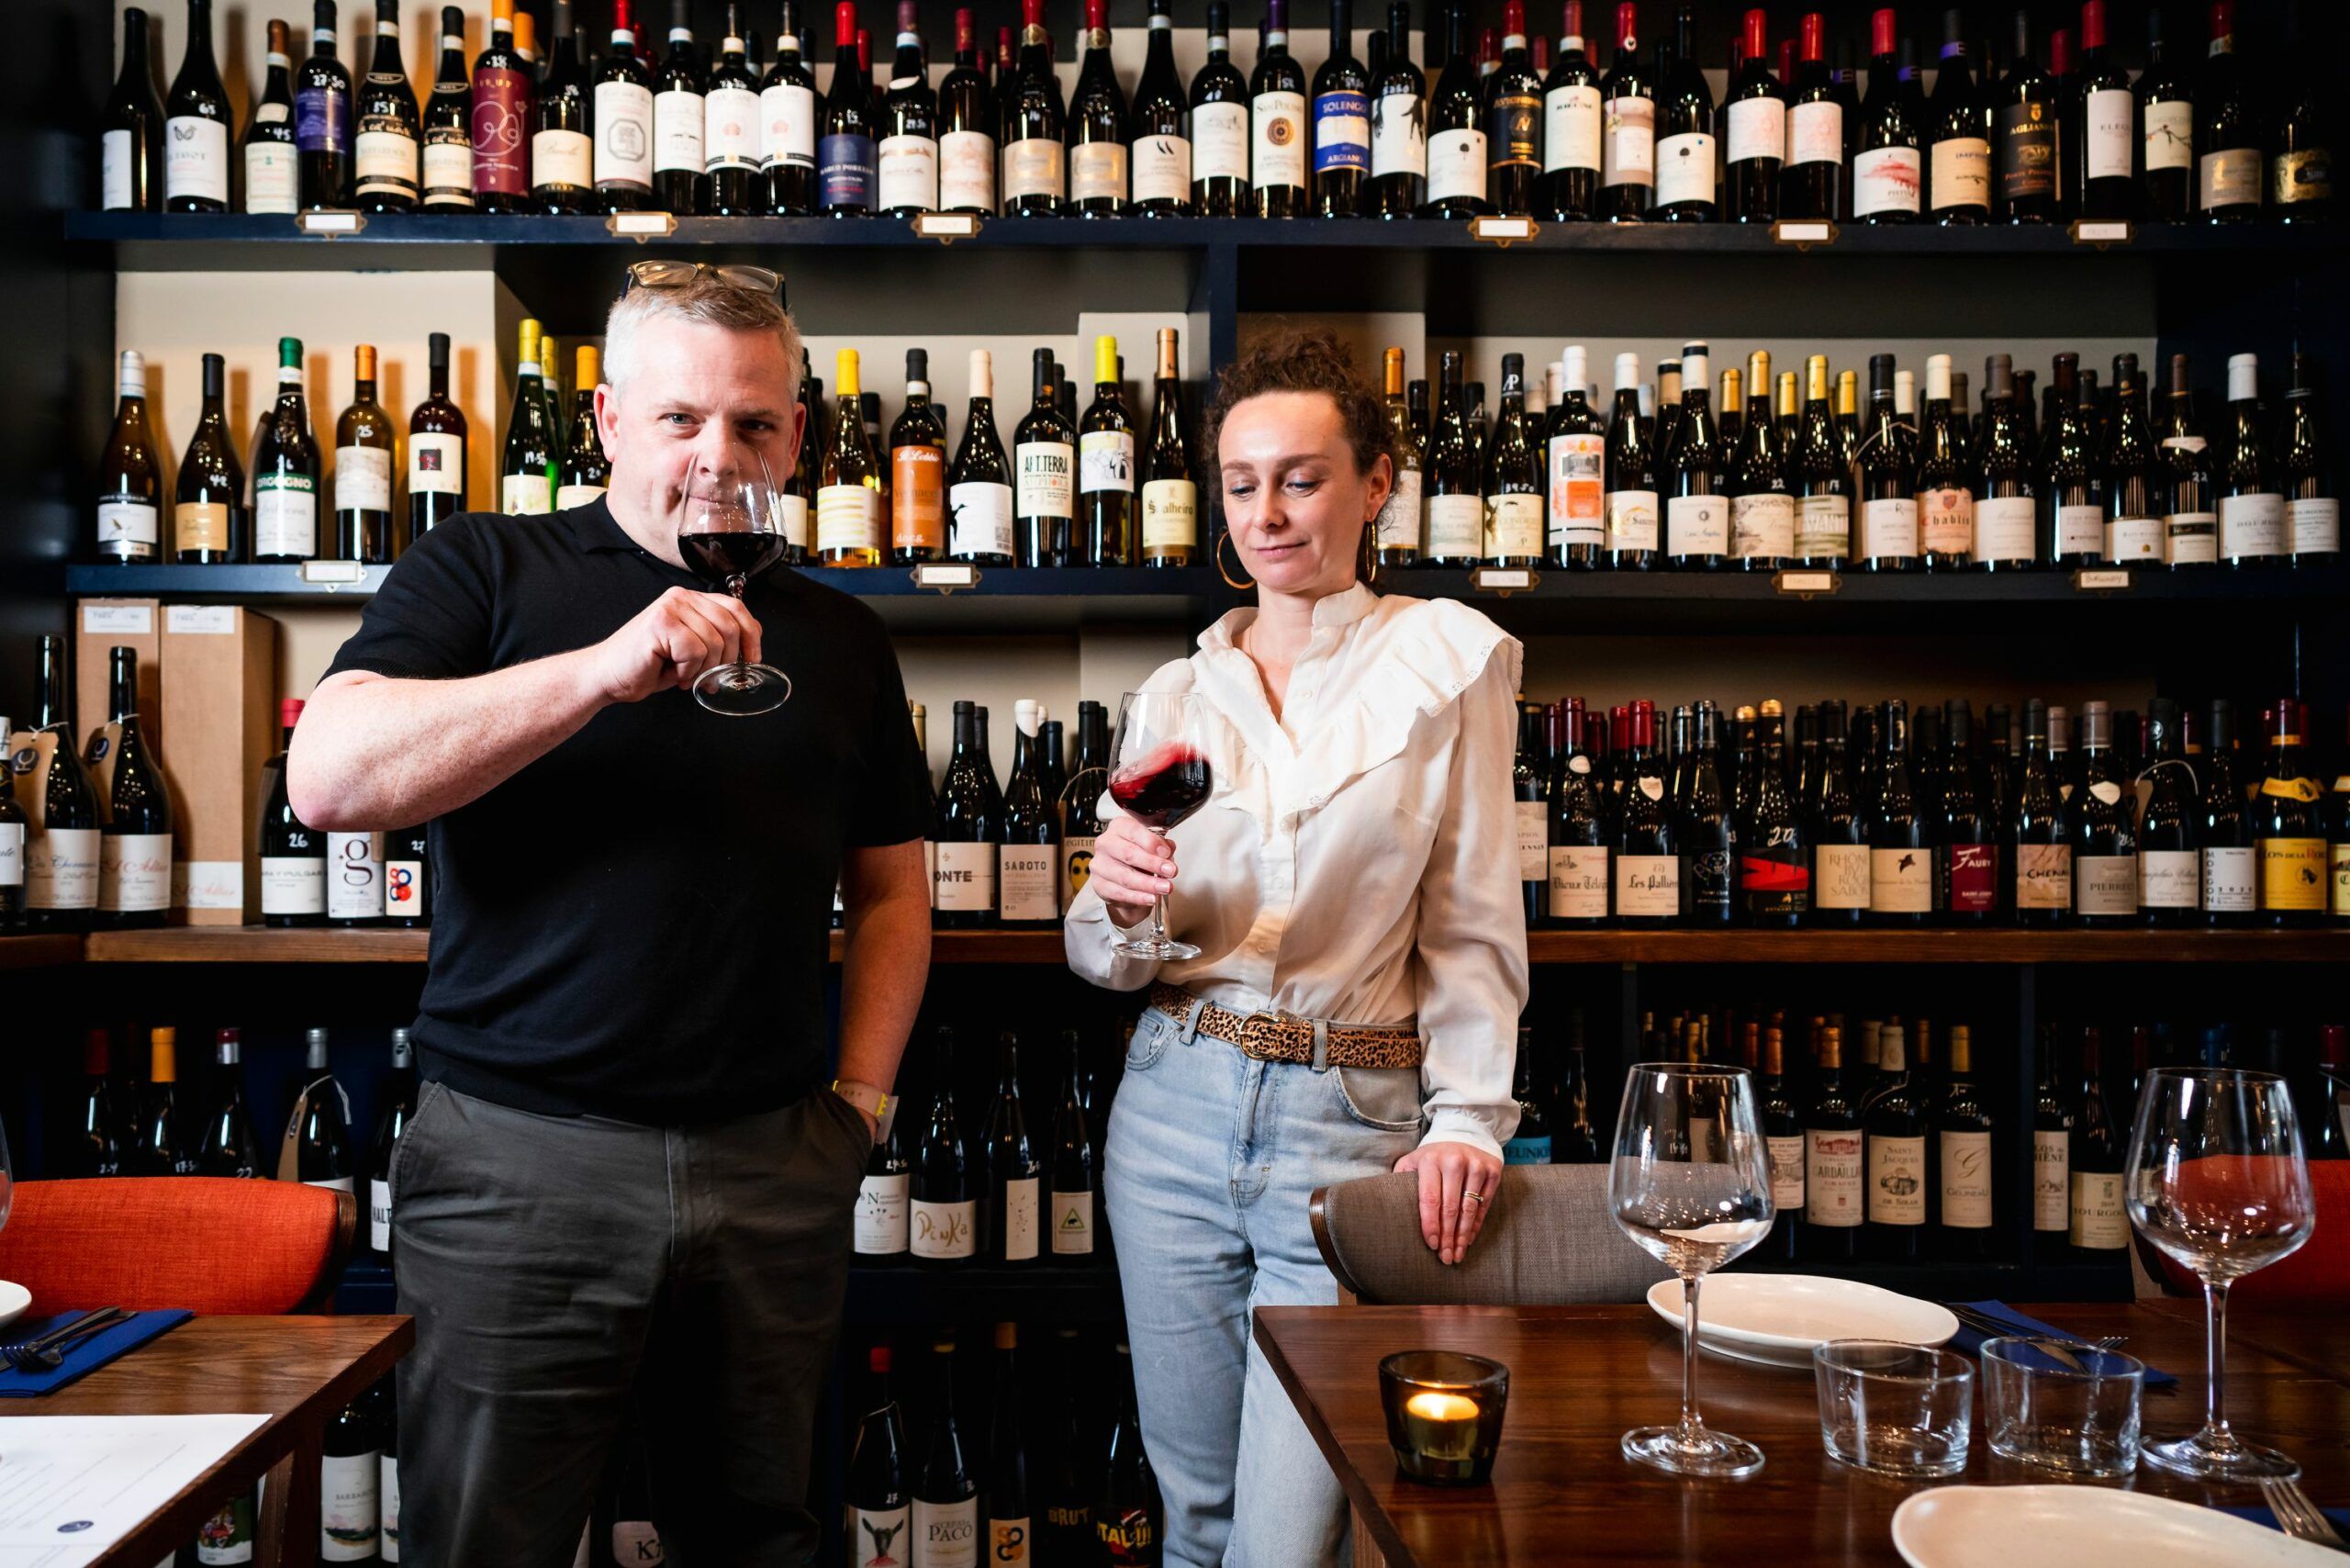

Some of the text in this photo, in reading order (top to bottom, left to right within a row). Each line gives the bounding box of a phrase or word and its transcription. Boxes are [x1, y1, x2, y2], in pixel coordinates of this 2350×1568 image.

[289, 833, 308, 848] 26
[1004, 861, 1046, 871] SAROTO
[928, 1524, 972, 1542] PACO
